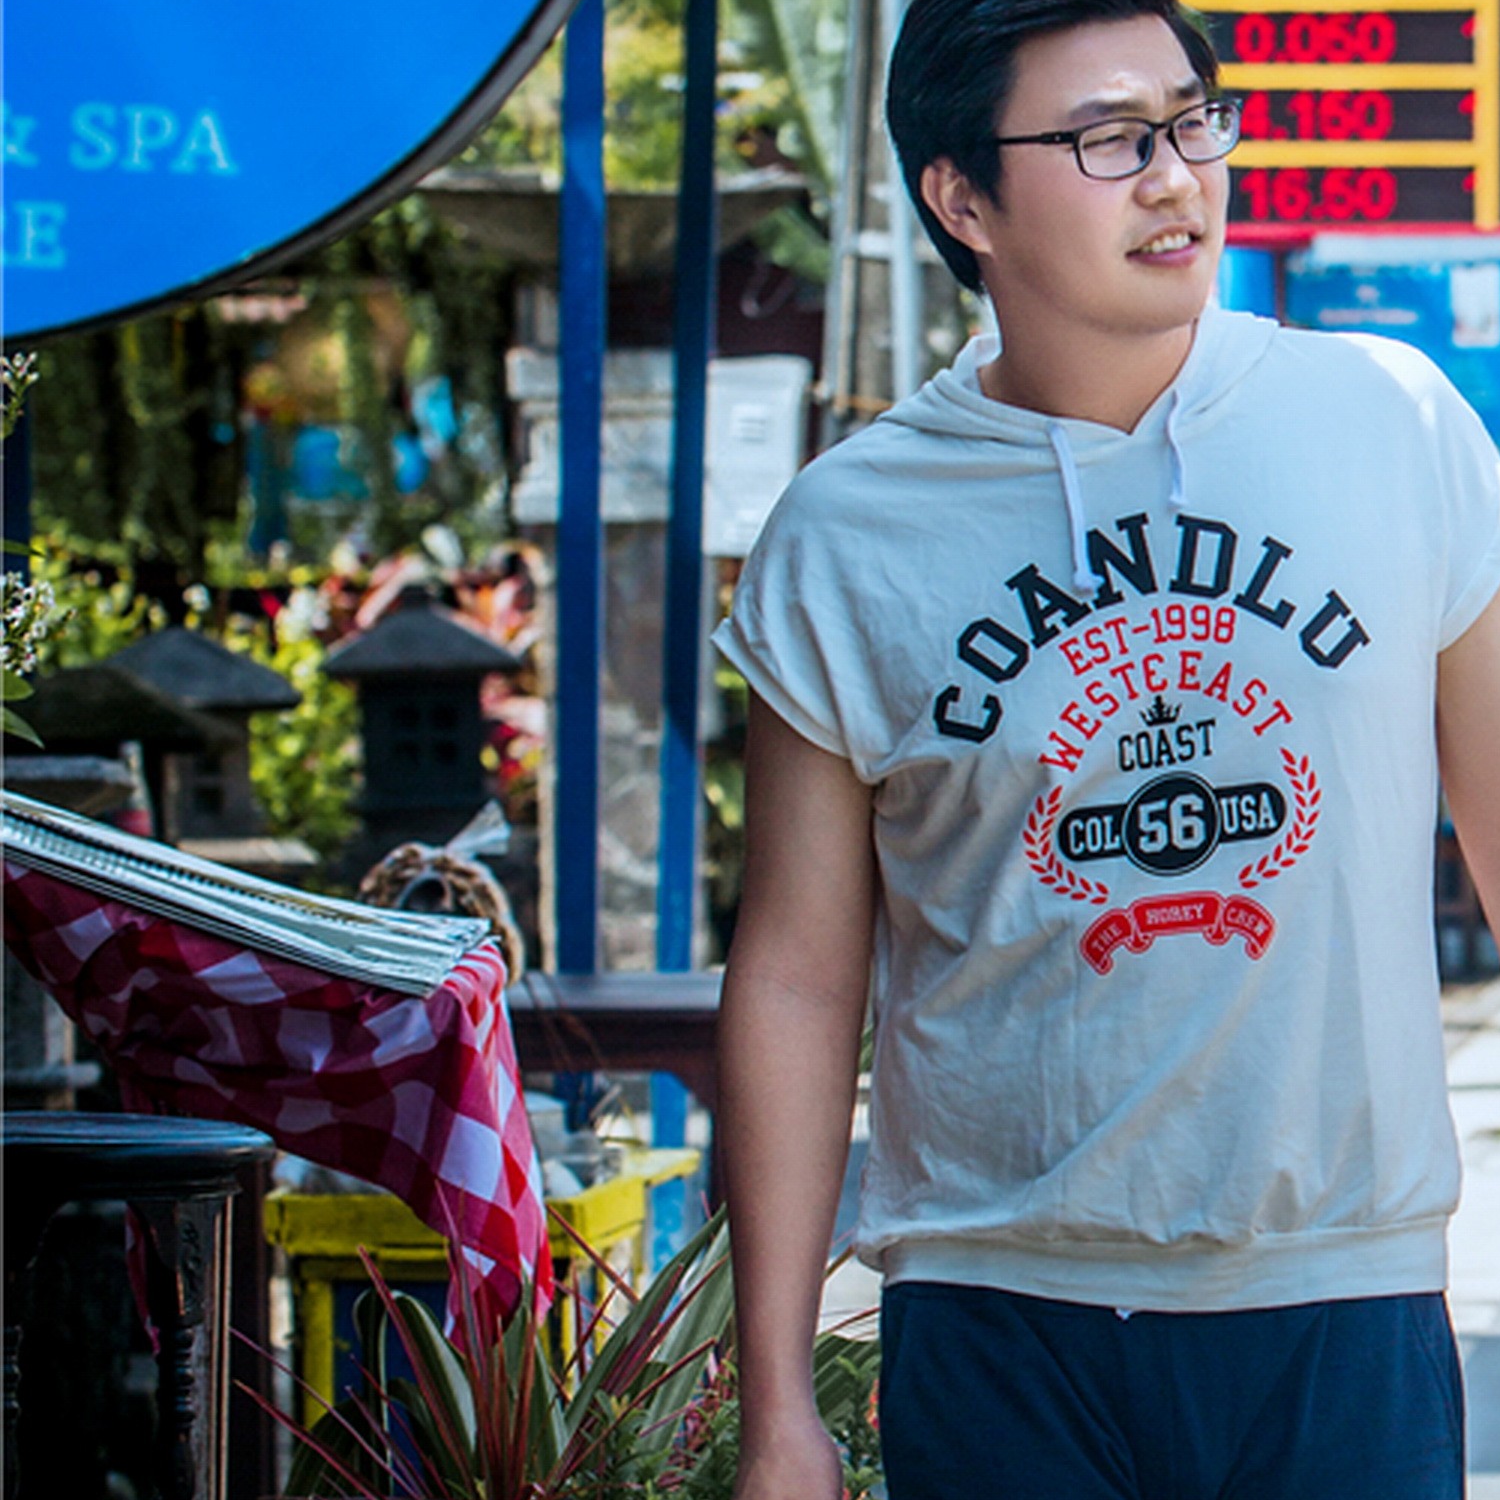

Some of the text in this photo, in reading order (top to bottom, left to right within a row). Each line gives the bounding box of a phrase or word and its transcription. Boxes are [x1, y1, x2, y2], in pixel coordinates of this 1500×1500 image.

[69, 101, 241, 176] SPA
[933, 512, 1373, 744] COANDLU
[1058, 603, 1237, 677] EST-1998
[1117, 717, 1217, 772] COAST
[1067, 790, 1278, 856] COL 56 USA
